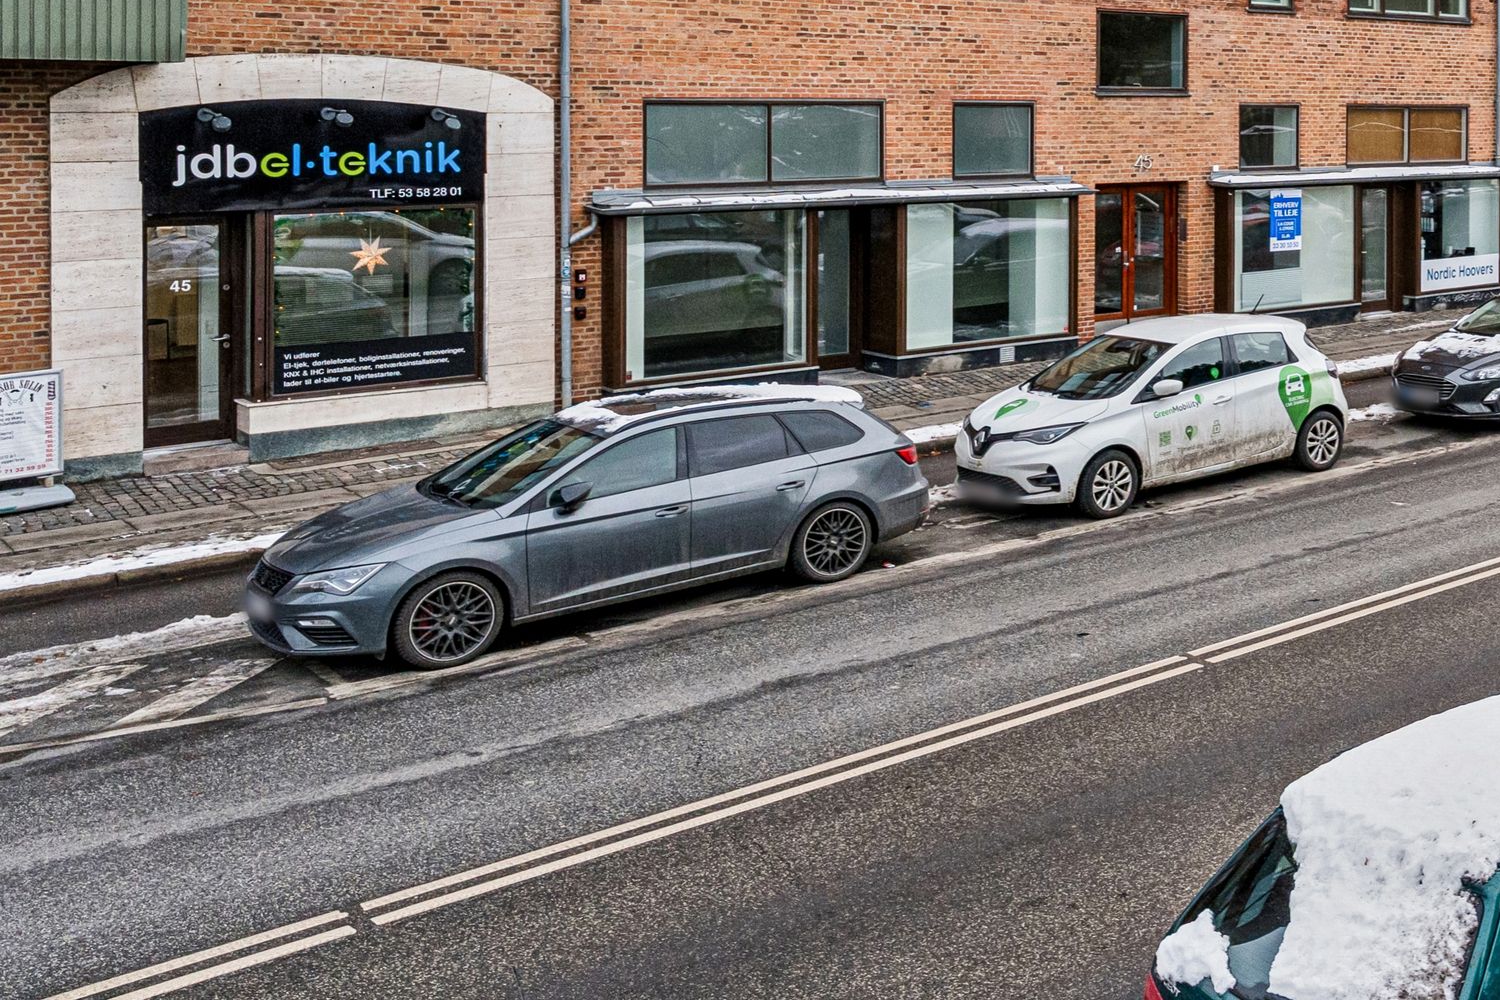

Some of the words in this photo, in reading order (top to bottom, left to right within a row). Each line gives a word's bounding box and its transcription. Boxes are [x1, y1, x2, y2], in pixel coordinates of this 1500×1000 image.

[1134, 154, 1153, 170] 45
[369, 188, 396, 199] TLF:
[398, 187, 413, 198] 53
[416, 187, 431, 198] 58
[433, 187, 447, 197] 28
[449, 186, 462, 197] 01
[1274, 209, 1284, 217] TIL
[1284, 208, 1299, 217] LEJE
[1426, 266, 1457, 281] Nordic
[1458, 264, 1494, 277] Hoovers
[169, 280, 192, 293] 45
[284, 370, 300, 378] KNX
[302, 369, 308, 377] &
[310, 368, 325, 376] IHC
[284, 379, 303, 388] lader
[341, 375, 352, 384] og
[1153, 399, 1200, 419] GreenMobility
